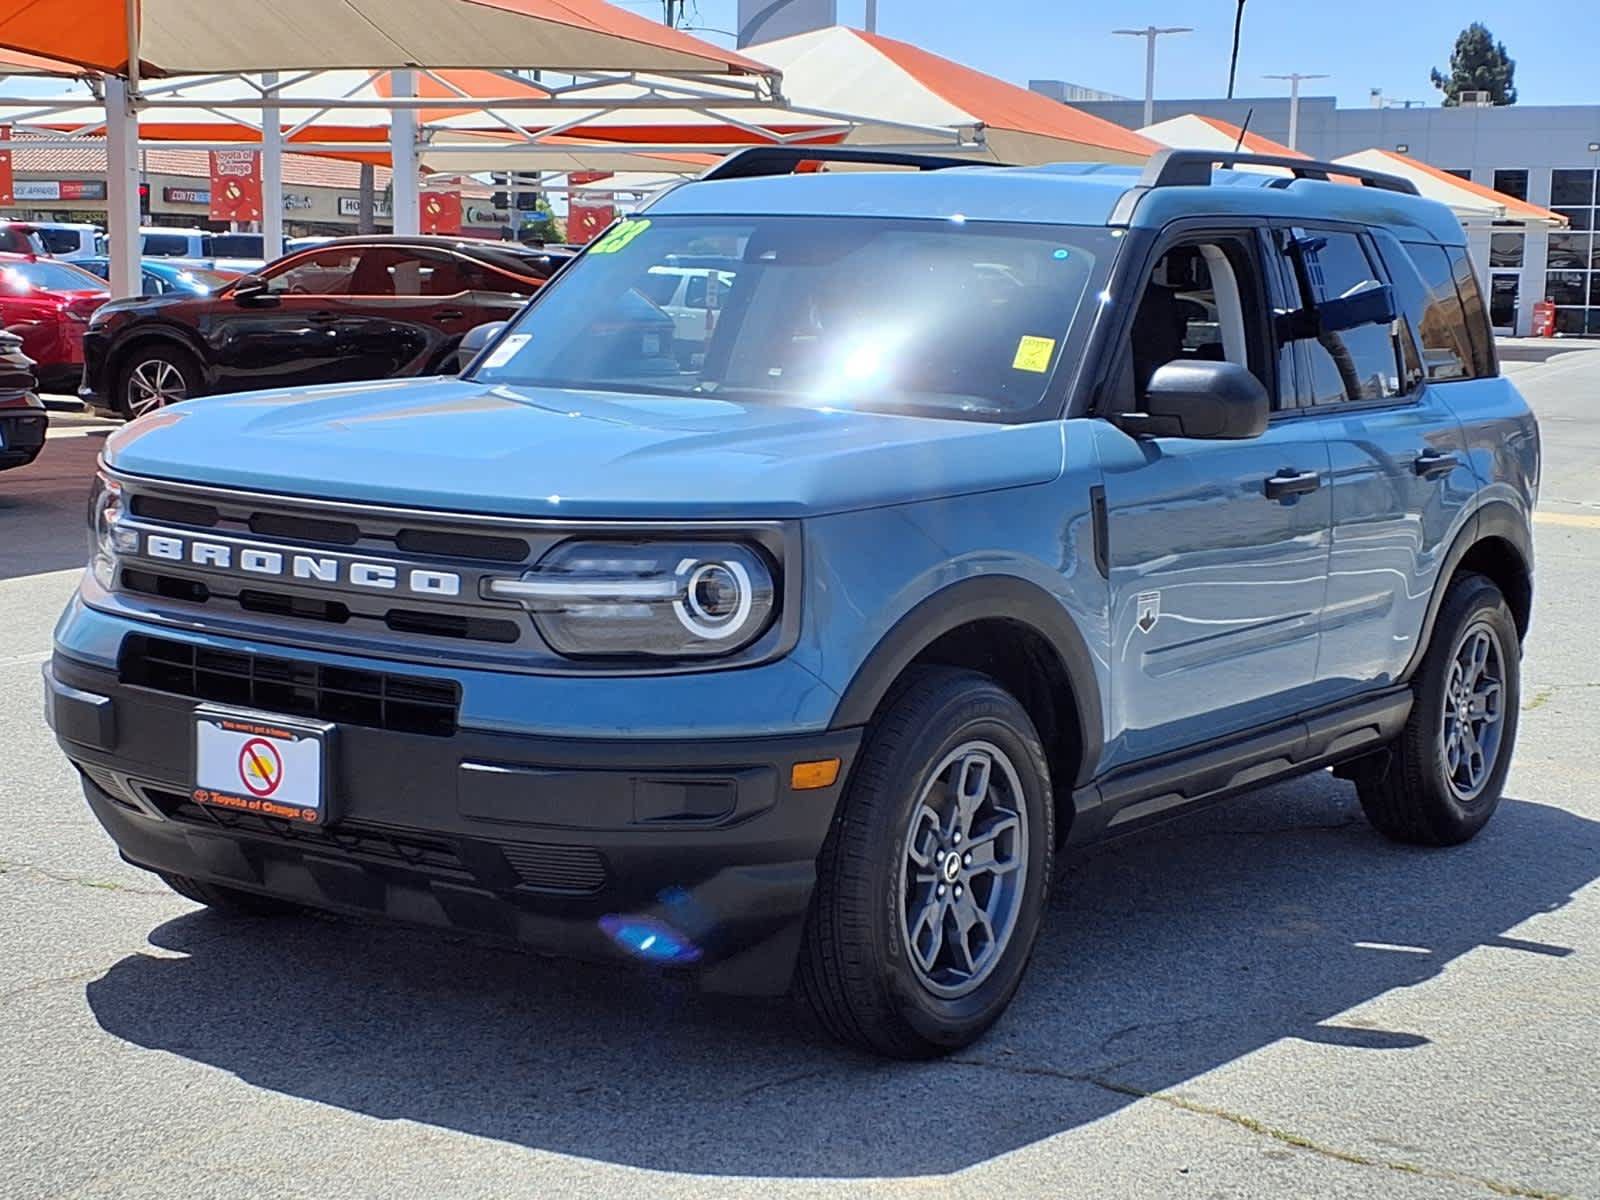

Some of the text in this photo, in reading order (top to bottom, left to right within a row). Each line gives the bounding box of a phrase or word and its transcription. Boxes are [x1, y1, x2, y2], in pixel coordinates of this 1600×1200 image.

[147, 535, 460, 596] BRONCO
[209, 791, 301, 818] Toyota of Orange
